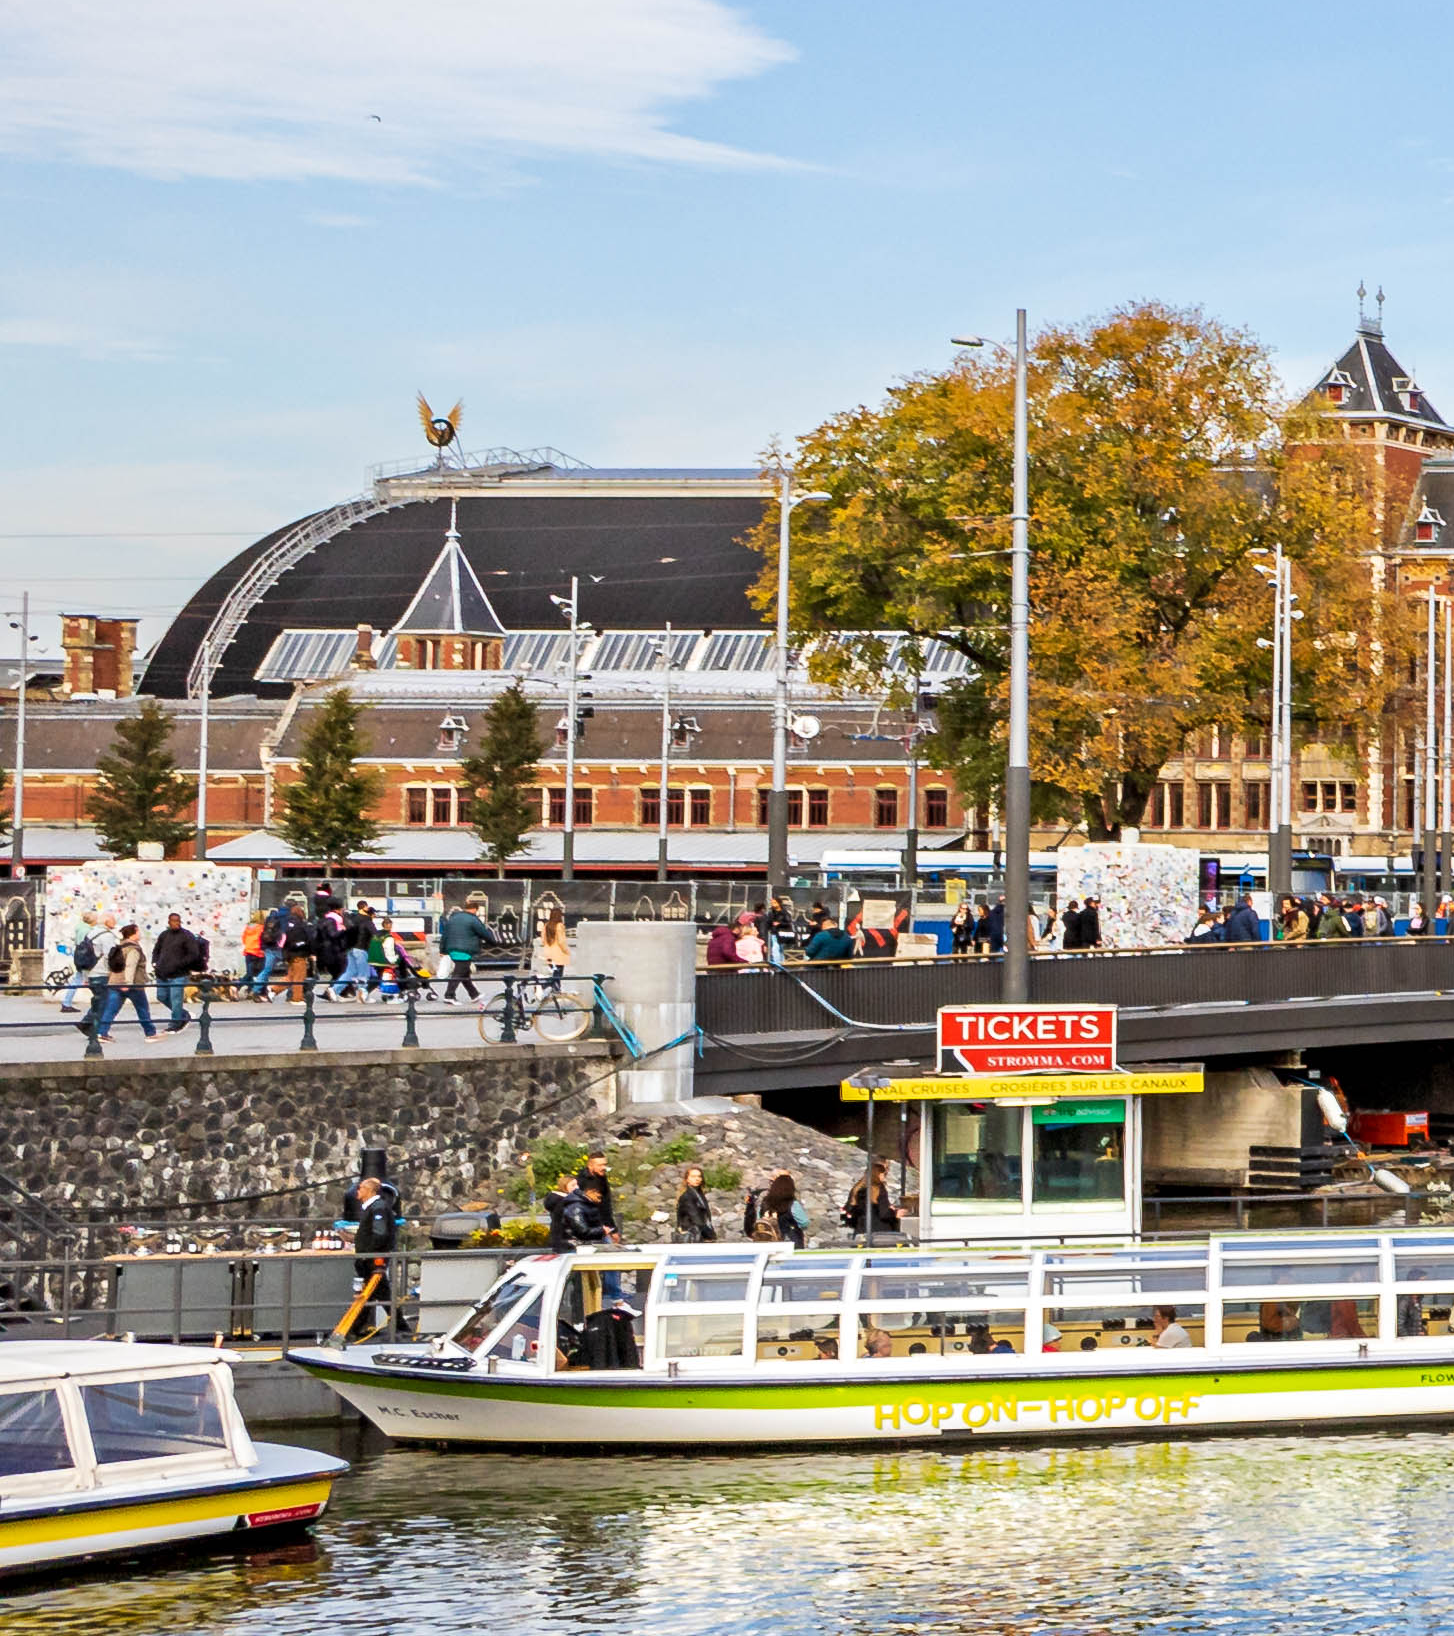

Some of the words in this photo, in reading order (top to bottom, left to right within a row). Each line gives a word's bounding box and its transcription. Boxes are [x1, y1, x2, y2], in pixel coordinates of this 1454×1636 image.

[955, 1014, 1100, 1041] TICKETS
[911, 1084, 969, 1095] CRUISES
[1071, 1080, 1099, 1091] SUR
[1102, 1079, 1128, 1090] LES
[1130, 1078, 1188, 1090] CANAUX
[409, 1408, 461, 1421] Escher
[873, 1396, 953, 1430] HOP
[1134, 1391, 1201, 1424] OFF
